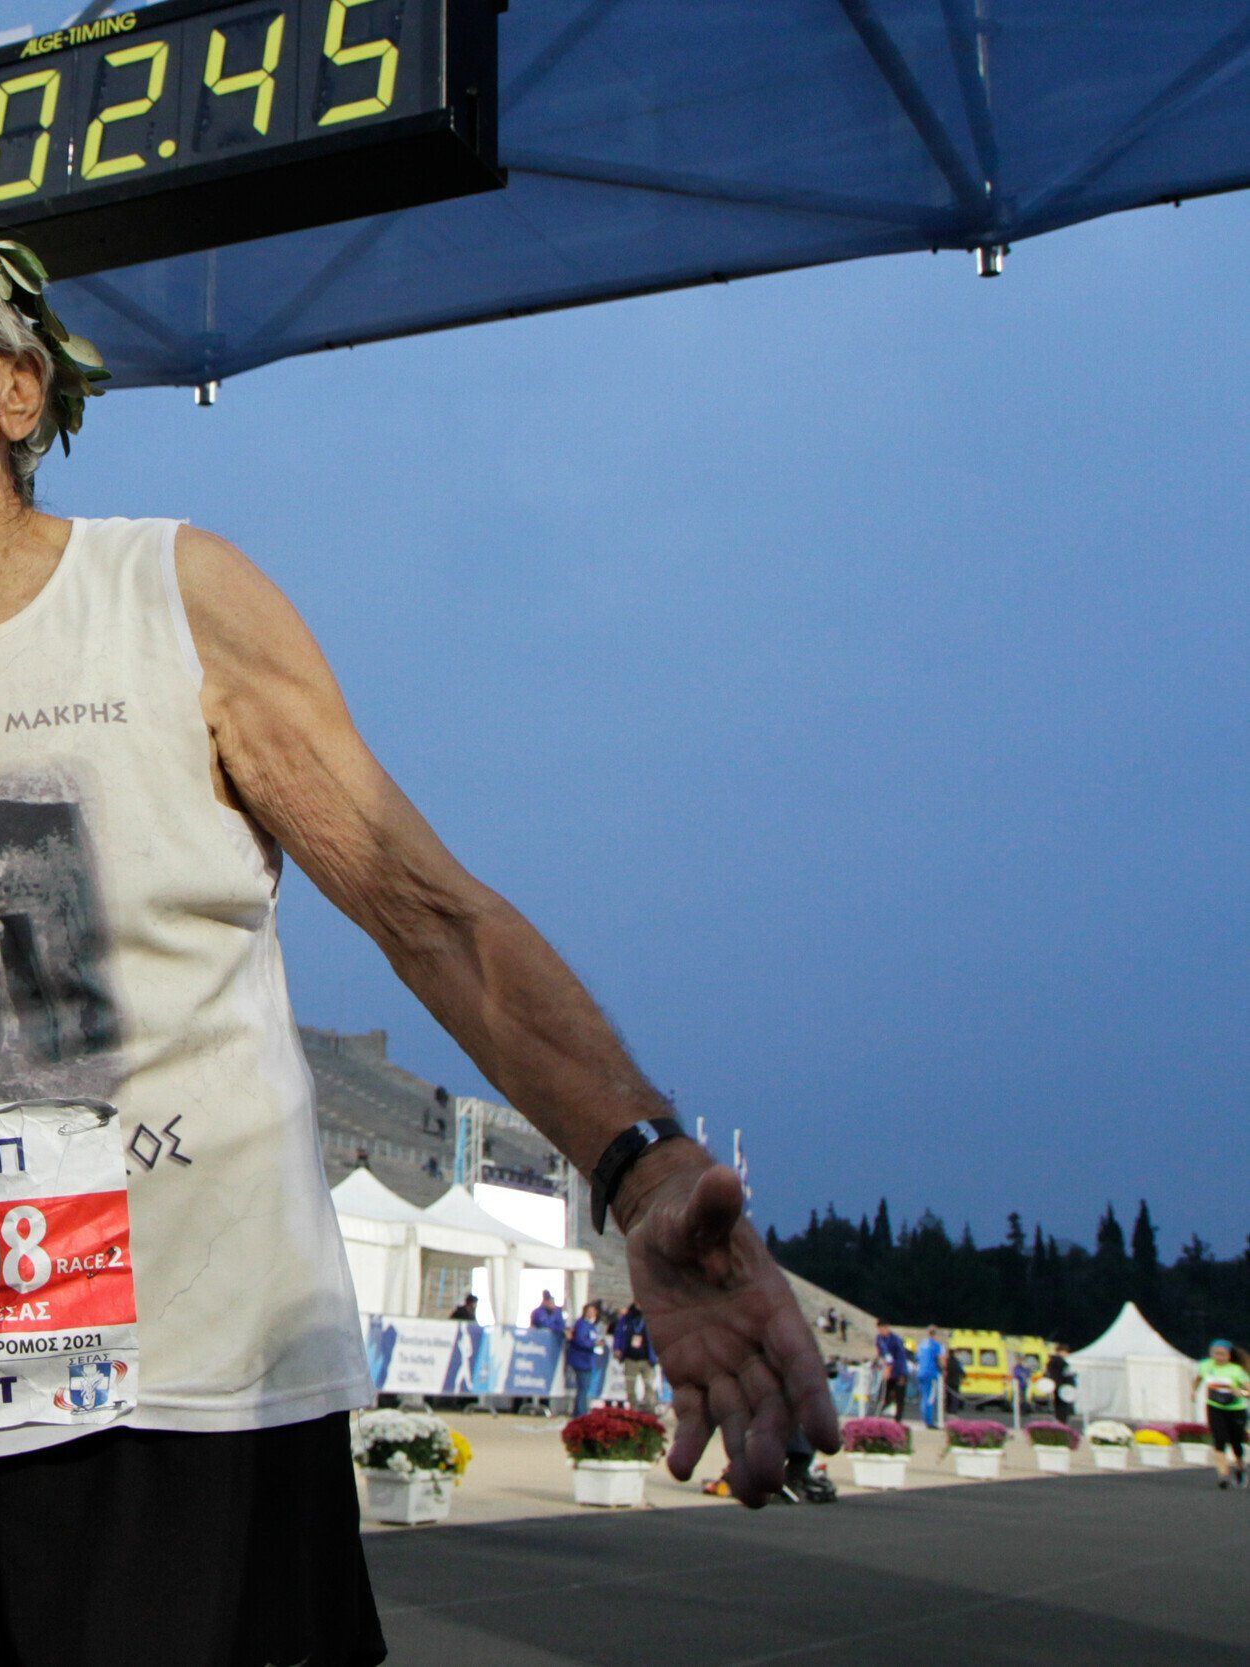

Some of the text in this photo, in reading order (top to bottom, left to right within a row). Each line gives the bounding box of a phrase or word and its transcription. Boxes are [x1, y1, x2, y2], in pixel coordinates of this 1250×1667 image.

[19, 11, 138, 59] ALGE-TIMING
[4, 701, 129, 735] ΜΑΚΡΗΣ
[56, 1245, 125, 1274] RACE 2
[63, 1333, 103, 1351] 2021
[69, 1353, 111, 1366] ΣΕΓΑΣ
